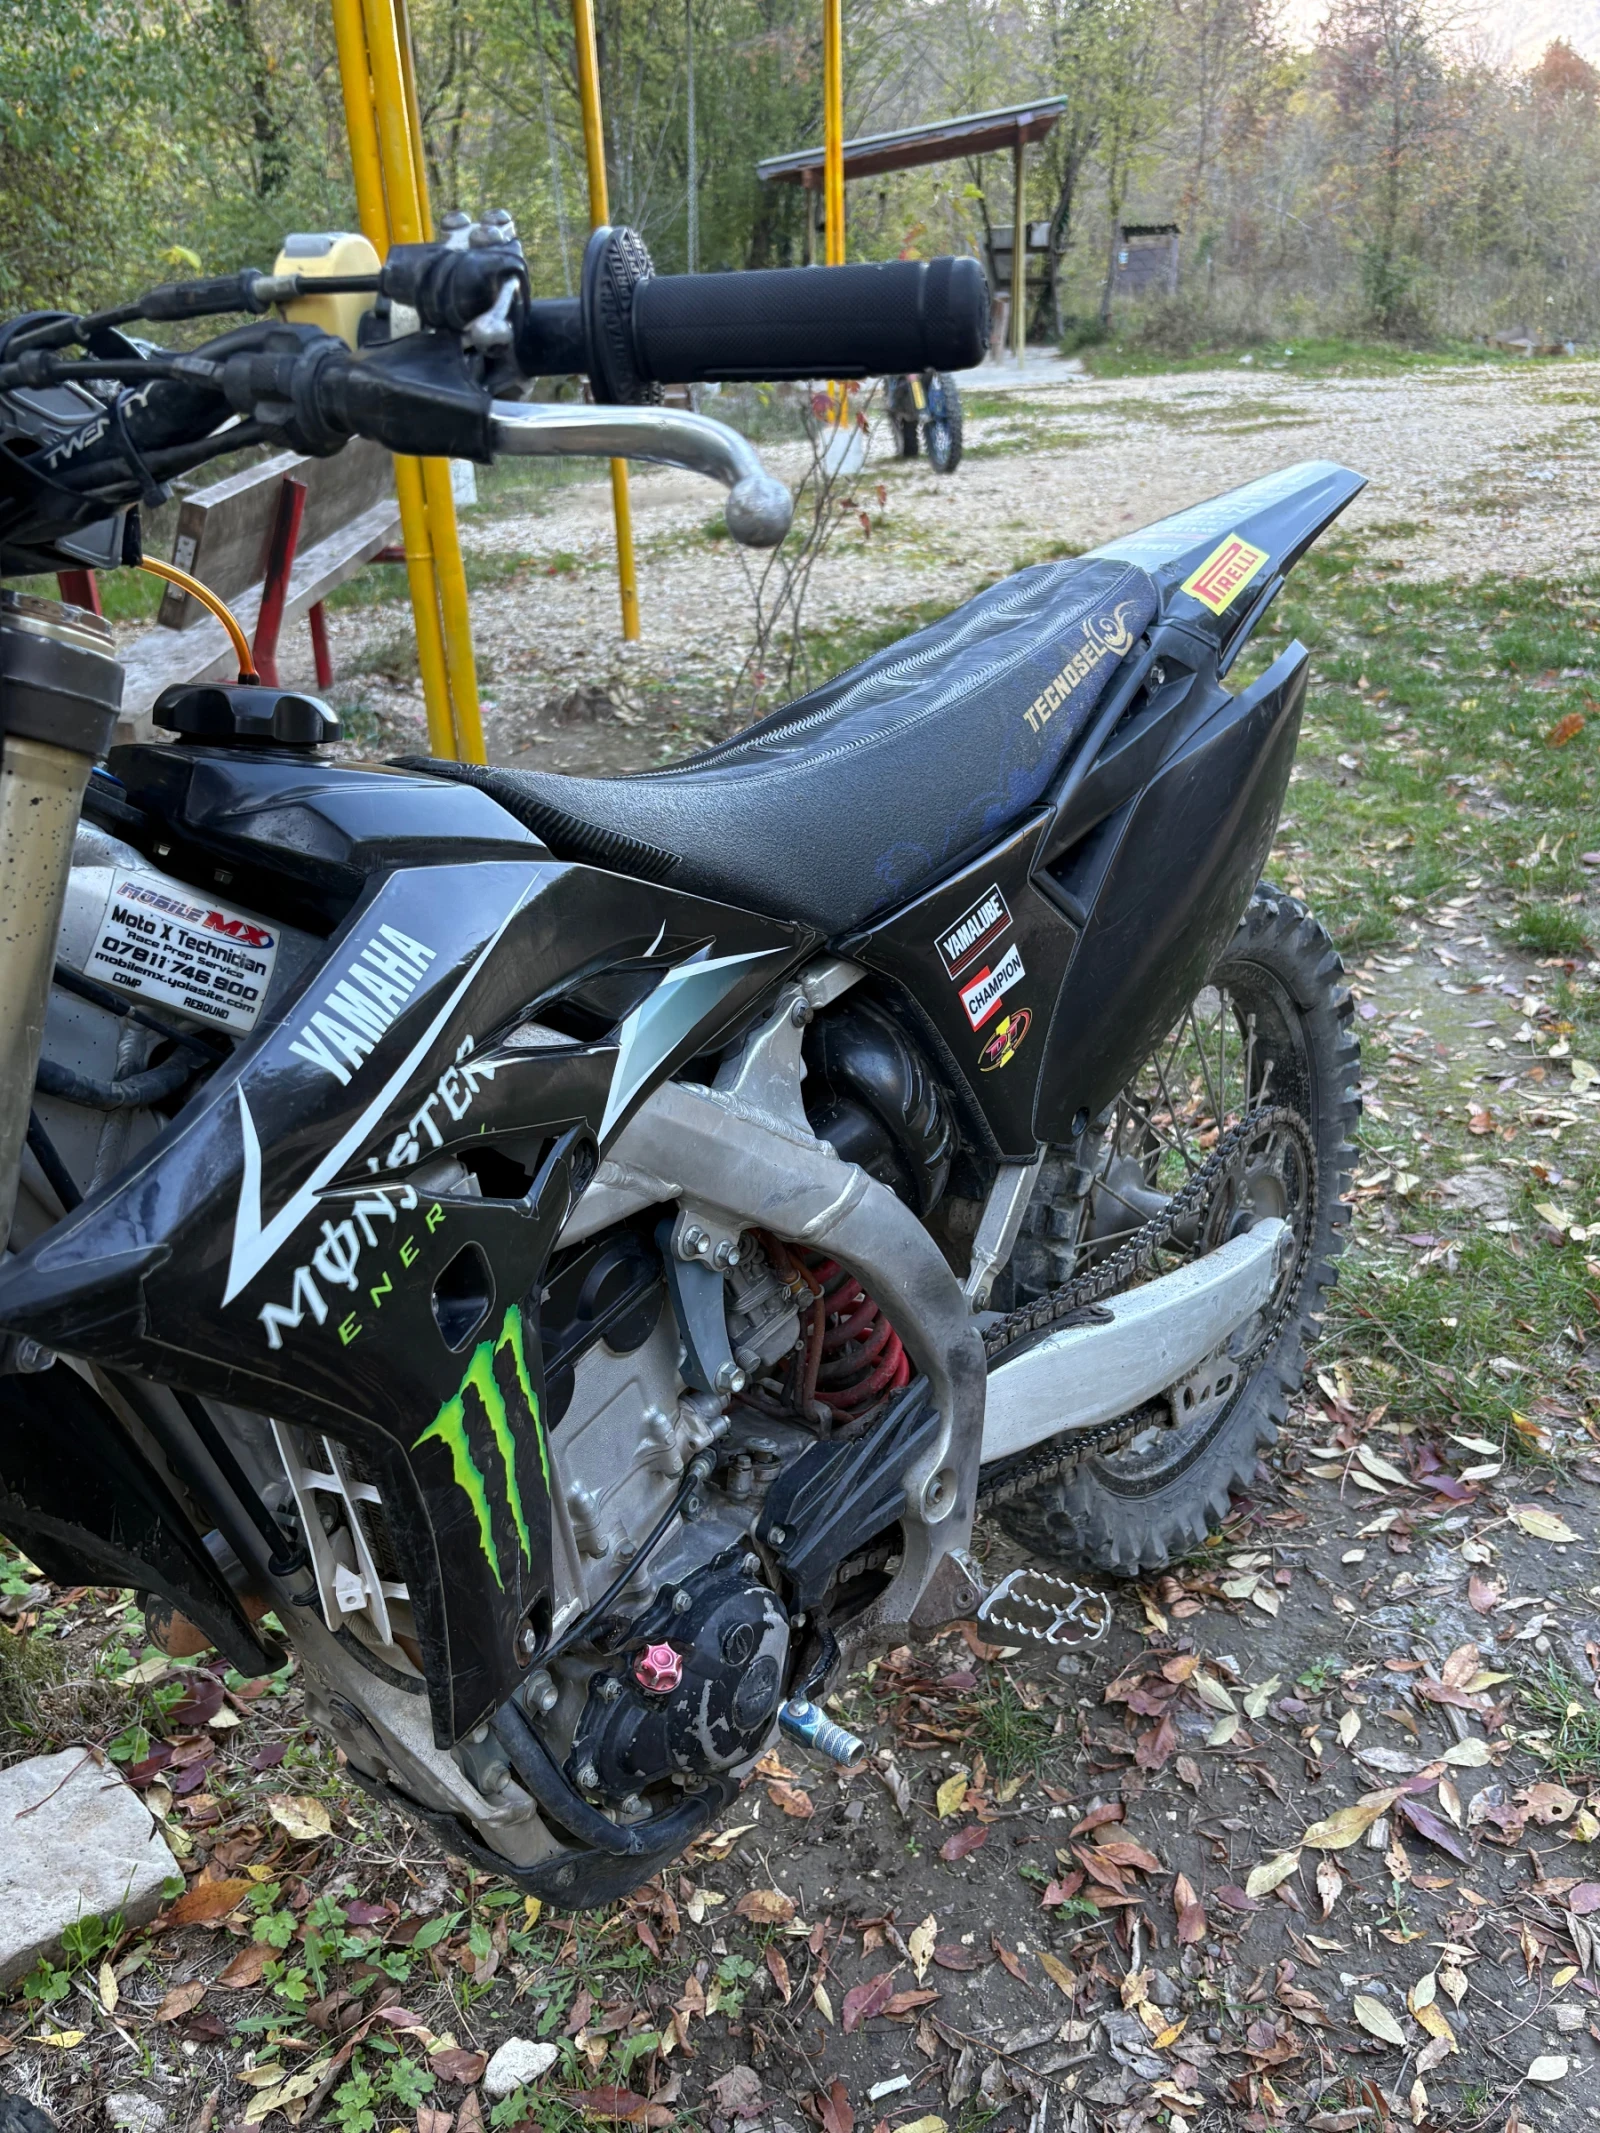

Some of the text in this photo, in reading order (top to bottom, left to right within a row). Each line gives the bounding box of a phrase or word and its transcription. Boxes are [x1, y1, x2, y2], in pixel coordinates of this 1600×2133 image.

[1191, 542, 1259, 605] PIRELLI
[111, 904, 267, 976] Moto X Technician
[117, 882, 272, 947] MOBILE MX
[943, 896, 1004, 960] YAMALUBE
[94, 951, 256, 1014] mobilemx.yolasite.com
[112, 972, 143, 989] COMP
[126, 929, 245, 980] Race Prep Service
[968, 954, 1021, 1015] CHAMPION
[183, 997, 230, 1020] REBOUND
[288, 923, 437, 1086] YAMAHA
[338, 1202, 447, 1346] ENER
